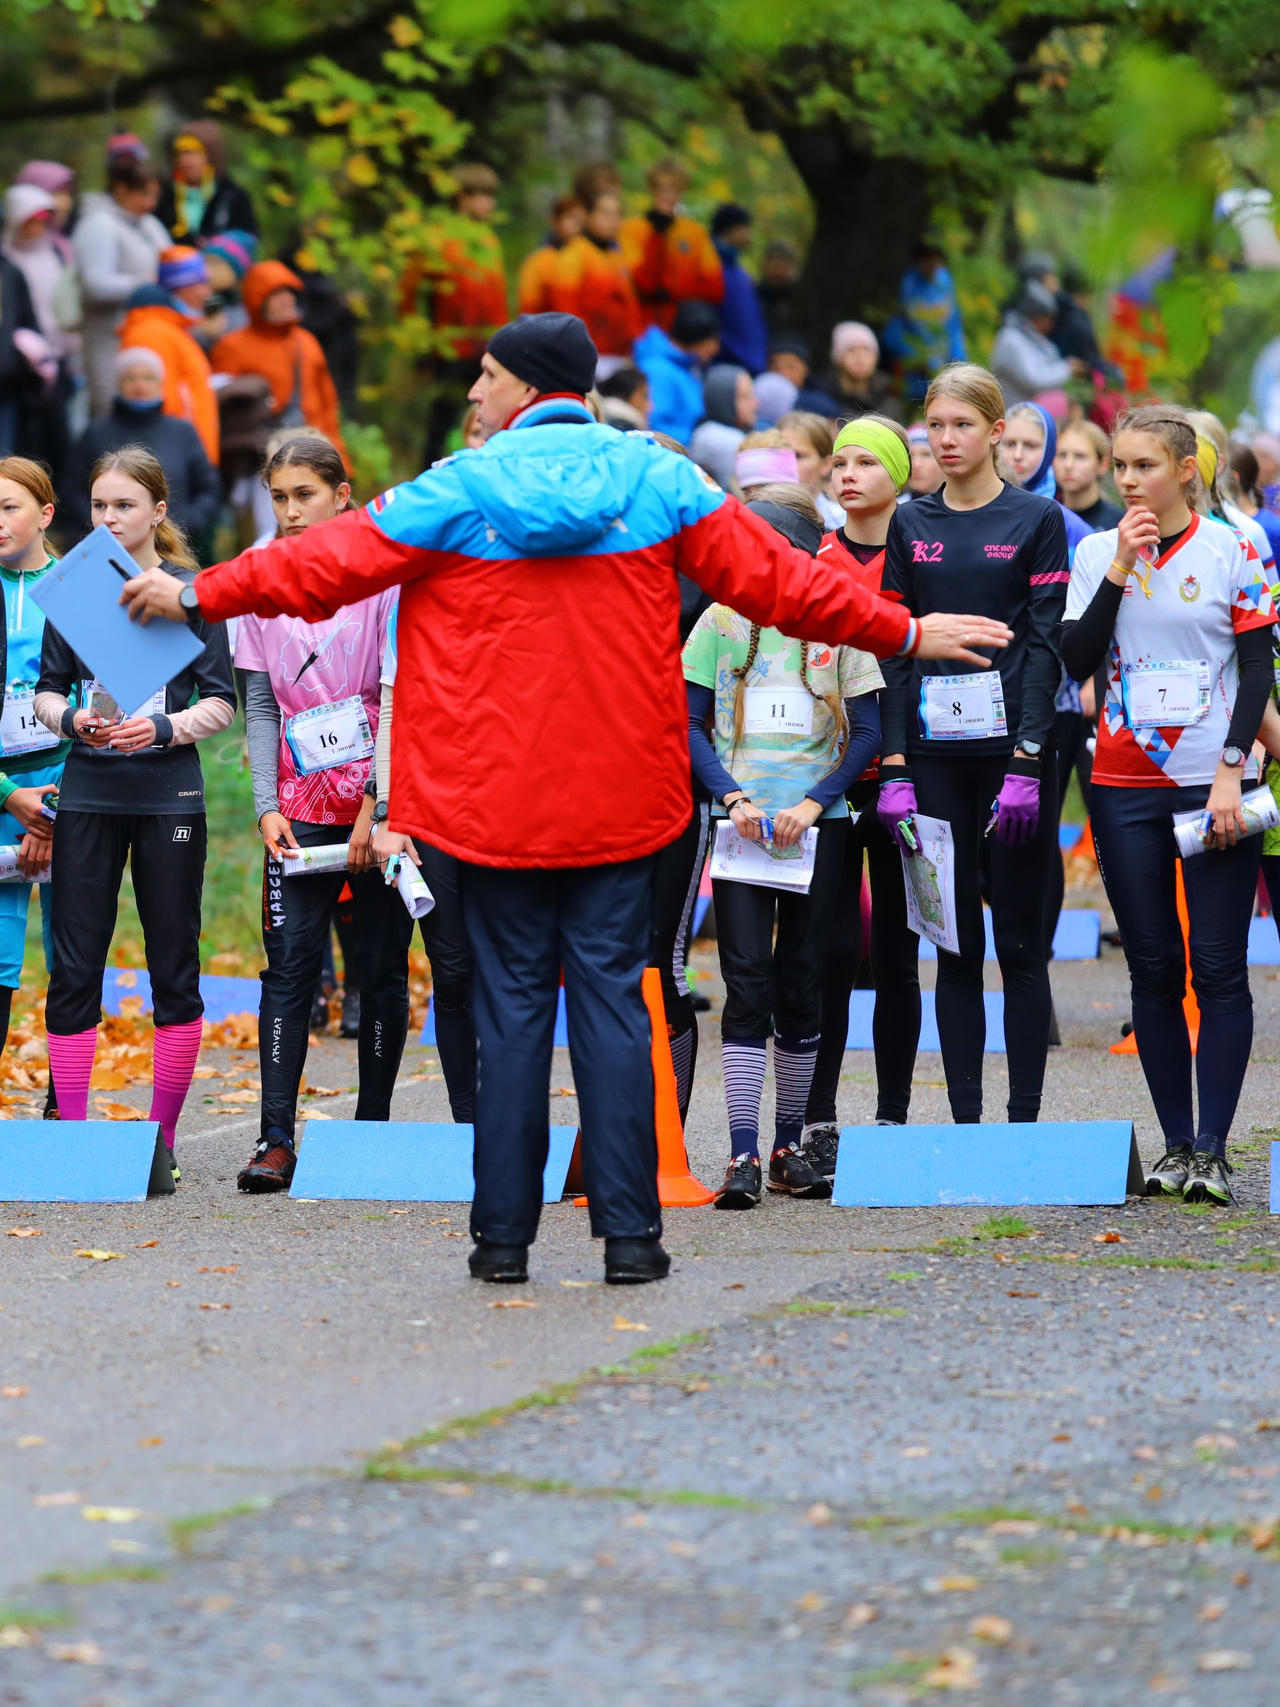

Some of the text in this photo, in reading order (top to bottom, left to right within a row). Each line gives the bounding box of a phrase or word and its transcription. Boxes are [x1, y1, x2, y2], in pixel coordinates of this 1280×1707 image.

[1158, 689, 1167, 703] 7
[771, 704, 786, 718] 11
[952, 702, 962, 716] 8
[20, 715, 37, 729] 14
[319, 731, 338, 748] 16
[272, 1018, 282, 1063] ARSWEAR
